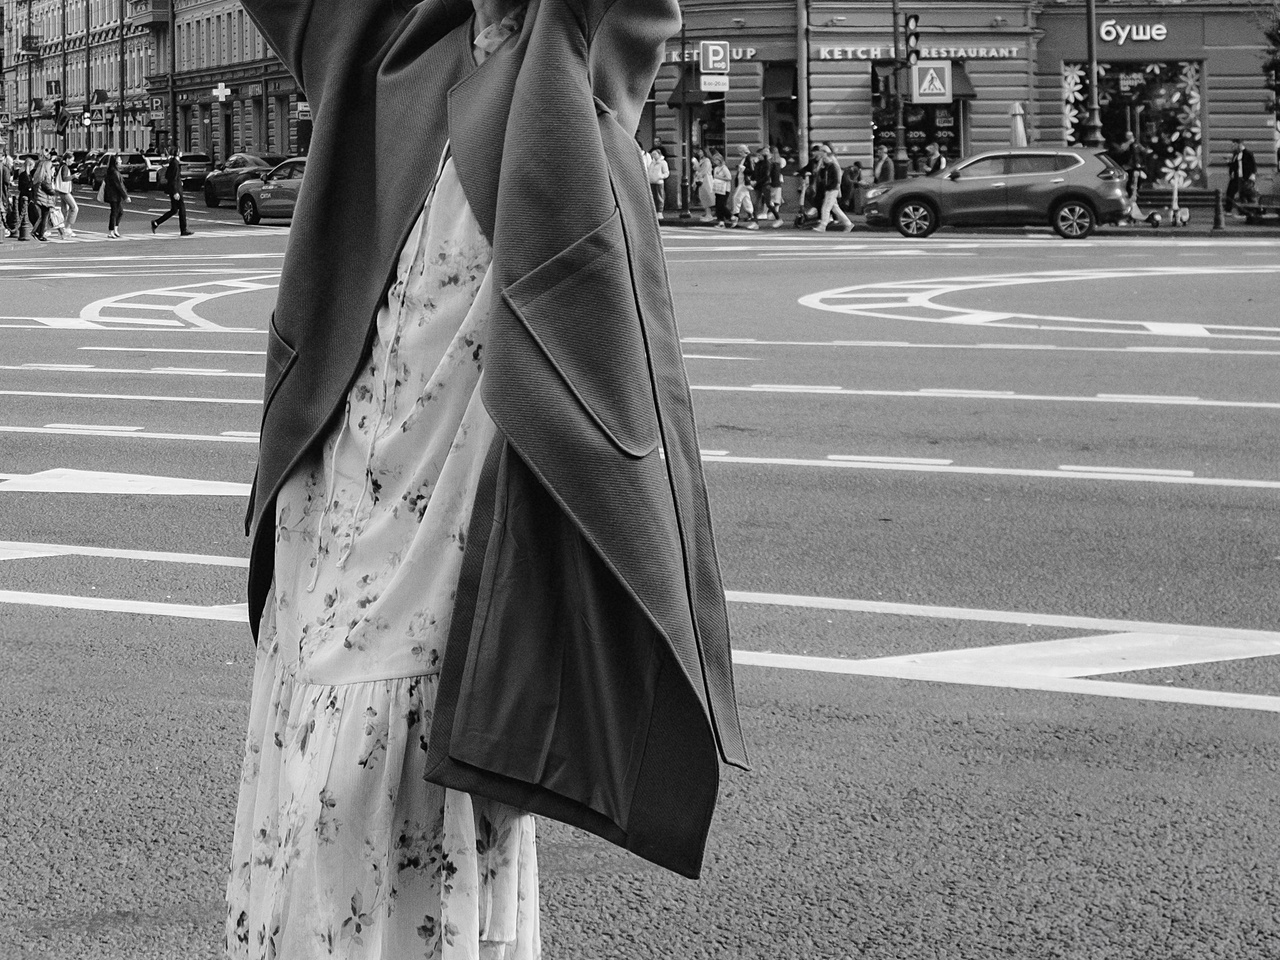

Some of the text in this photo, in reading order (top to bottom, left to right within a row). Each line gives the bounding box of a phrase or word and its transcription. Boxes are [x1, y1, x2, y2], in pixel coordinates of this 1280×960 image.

[1099, 19, 1167, 46] буше
[821, 47, 881, 59] KETCH
[921, 46, 1019, 58] RESTAURANT
